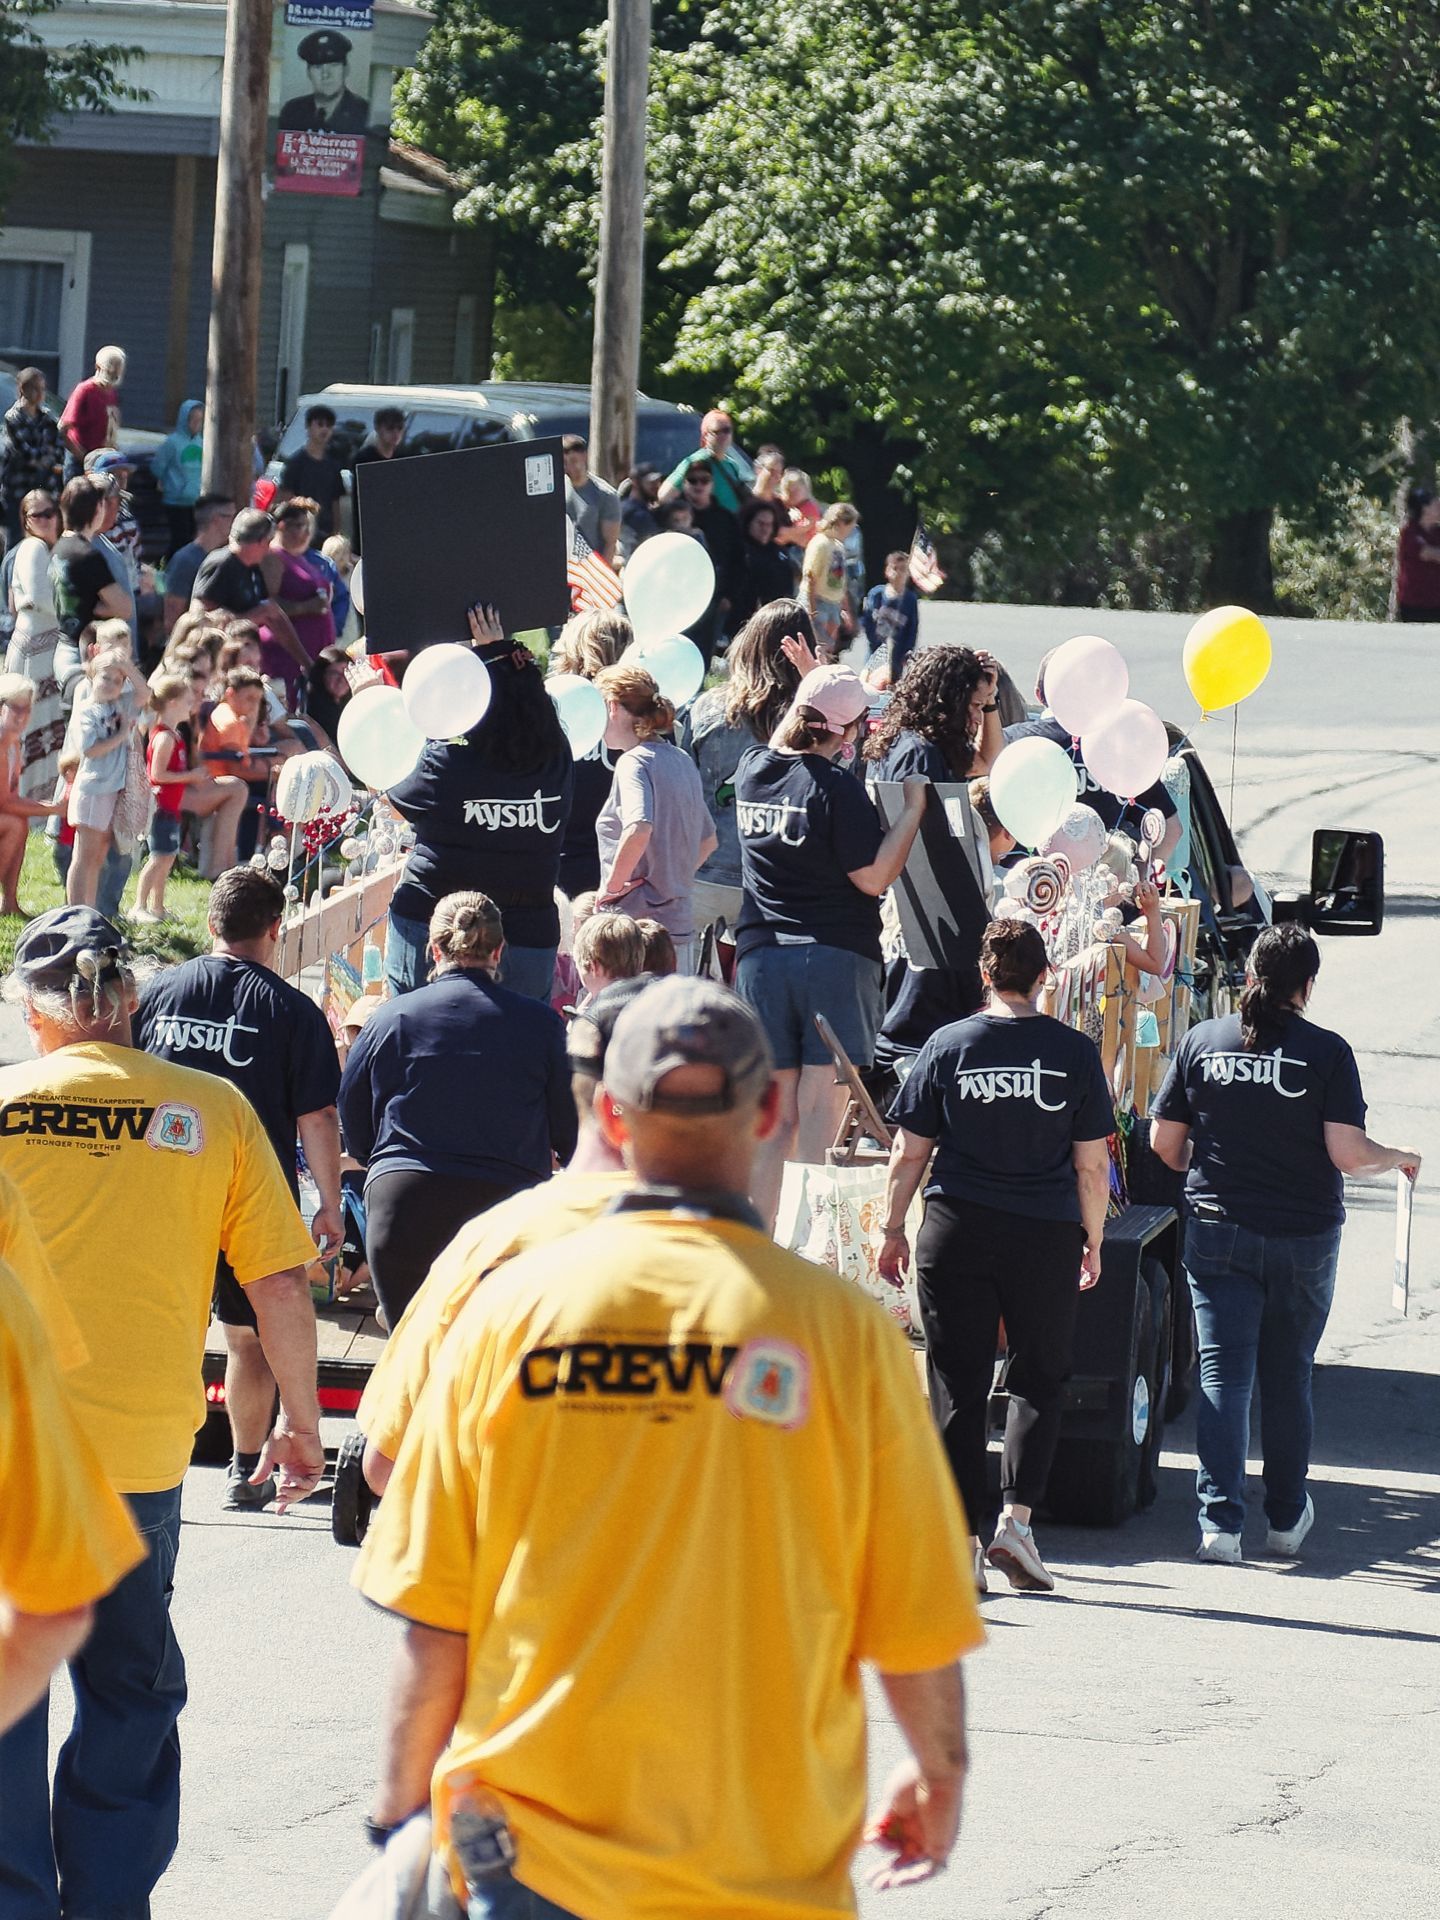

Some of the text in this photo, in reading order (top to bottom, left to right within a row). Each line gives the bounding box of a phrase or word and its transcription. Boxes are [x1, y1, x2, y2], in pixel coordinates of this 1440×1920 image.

[299, 144, 358, 160] Pomeroy
[308, 135, 358, 149] Warren
[463, 789, 562, 834] nysut
[155, 1014, 259, 1067] nysut
[957, 1058, 1067, 1112] nysut
[1200, 1047, 1307, 1098] nysut
[39, 1094, 71, 1102] ATLANTIC
[72, 1096, 98, 1104] STATES
[0, 1101, 155, 1141] CREW
[25, 1138, 122, 1152] STRONGER TOGETHER
[519, 1342, 740, 1399] CREW
